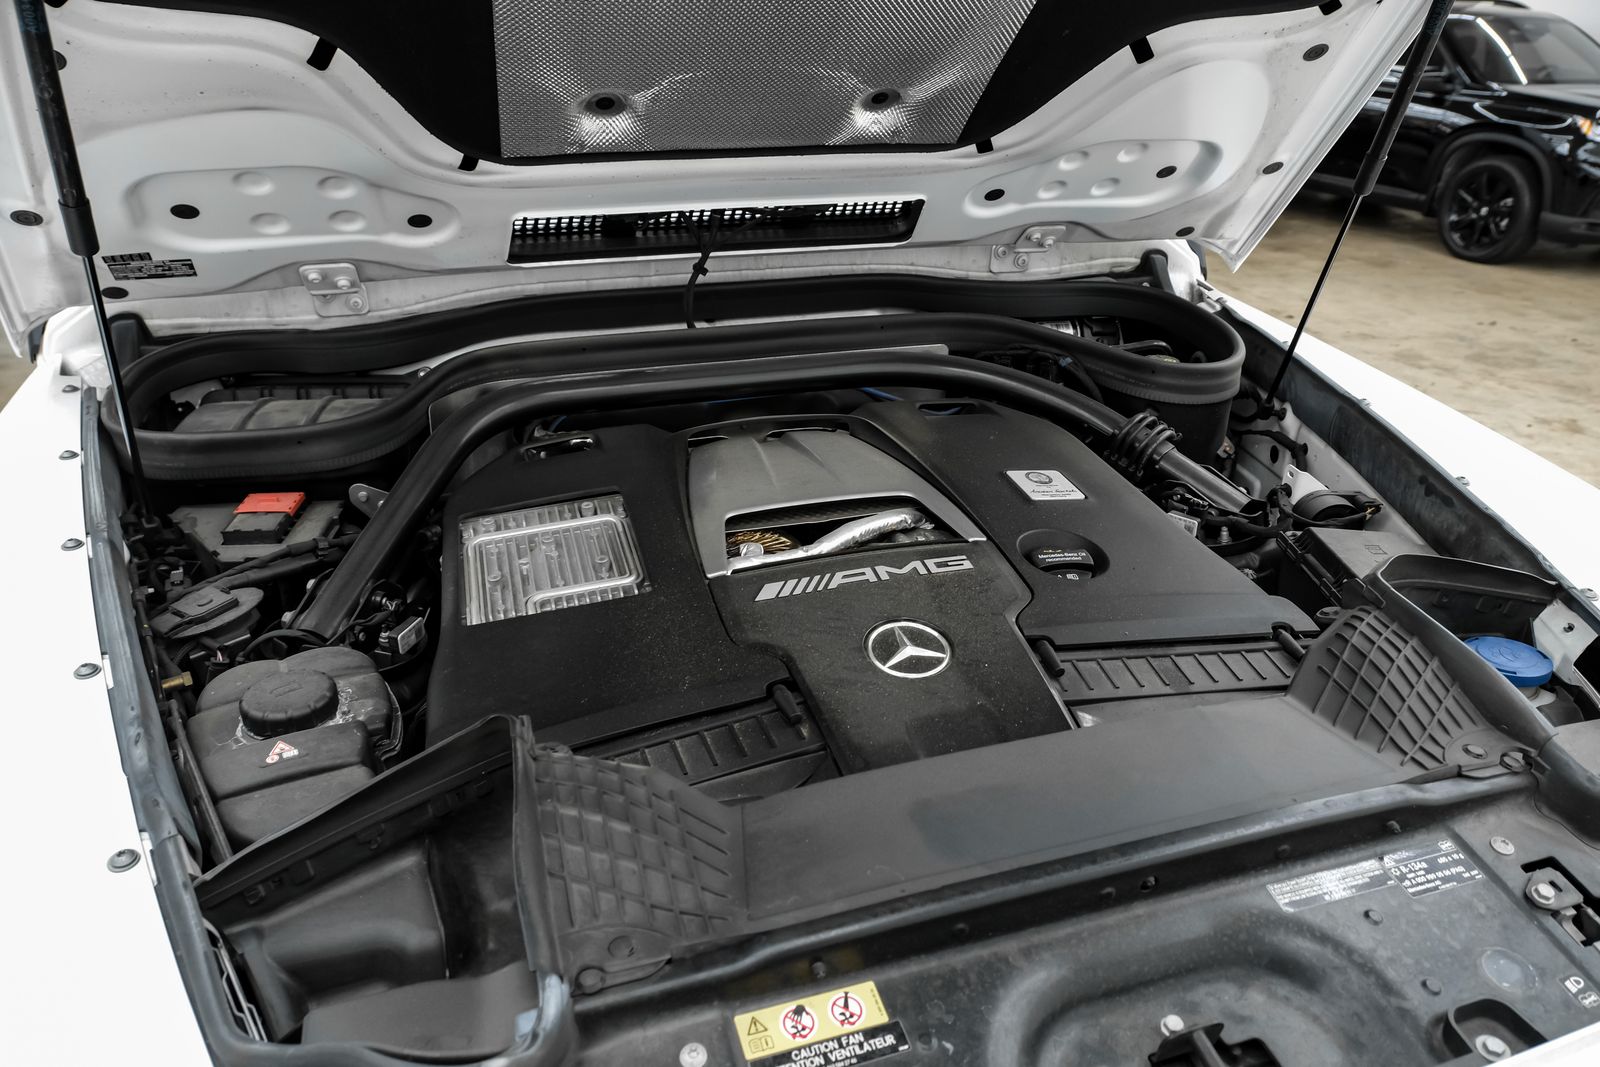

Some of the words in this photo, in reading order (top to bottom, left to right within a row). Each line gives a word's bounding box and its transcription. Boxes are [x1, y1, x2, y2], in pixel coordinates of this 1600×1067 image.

[827, 555, 974, 589] AMG
[791, 1039, 839, 1061] CAUTION
[841, 1032, 865, 1048] FAN
[827, 1033, 896, 1062] VENTILATEUR
